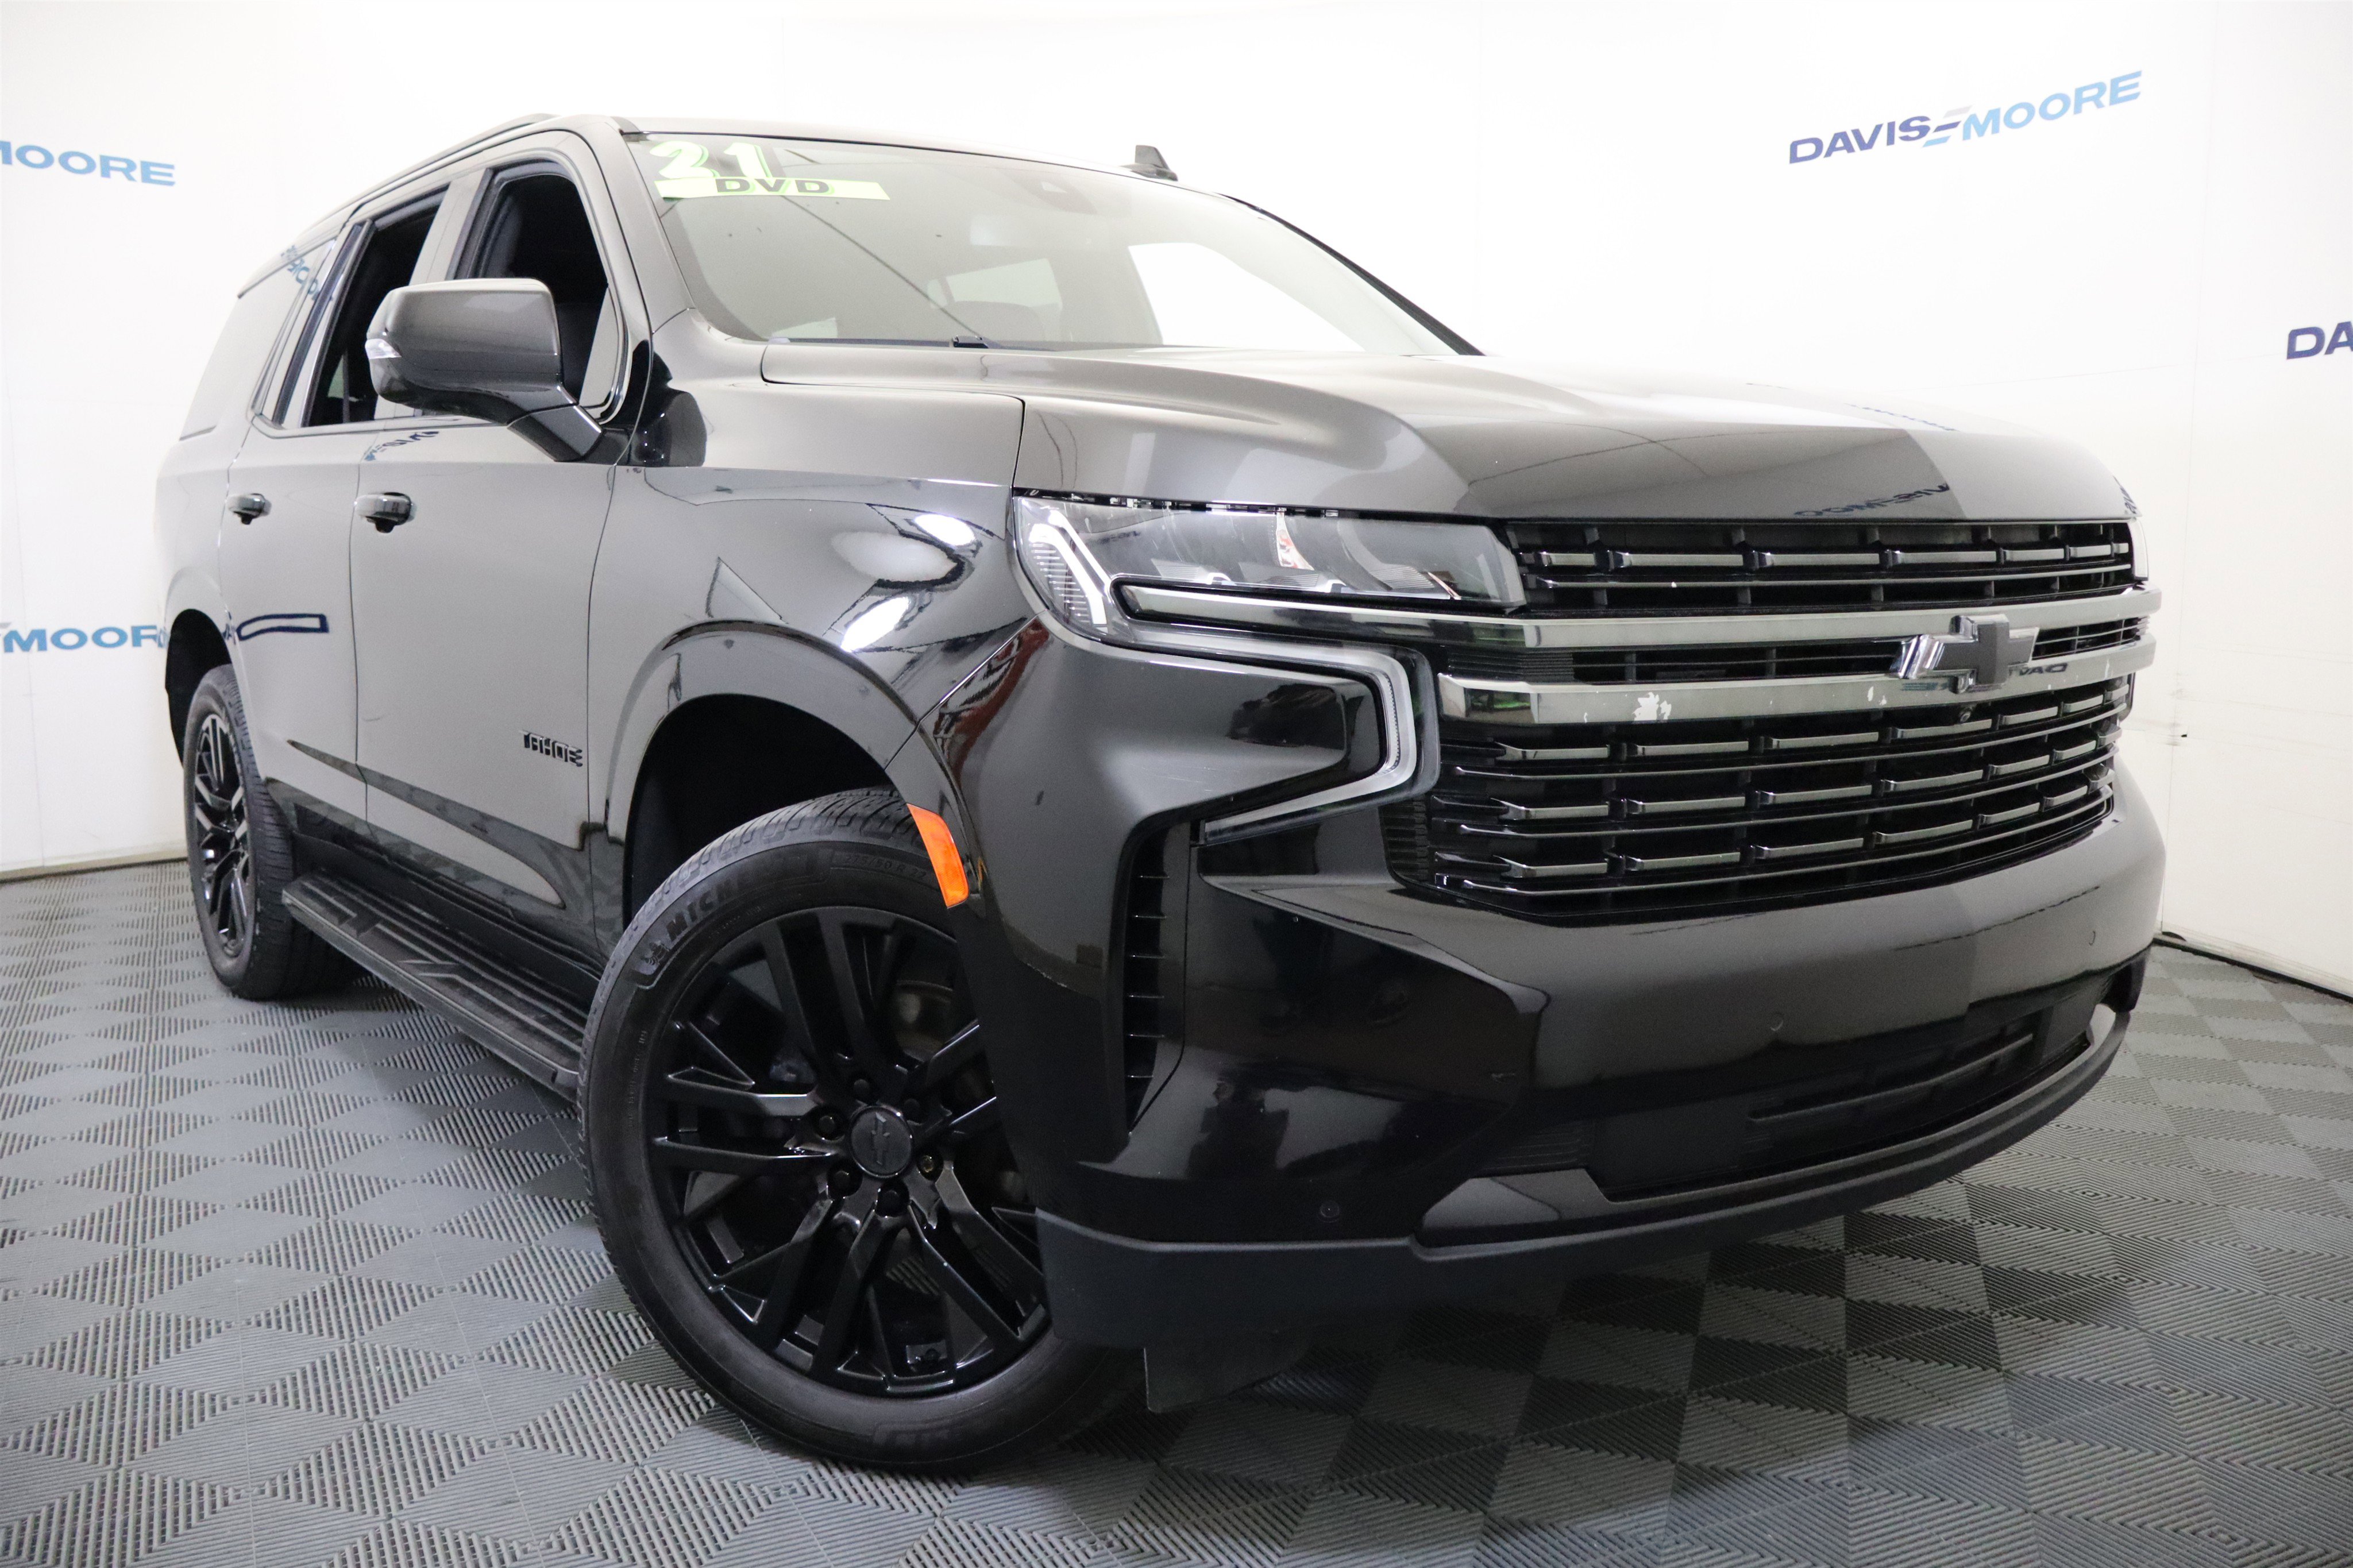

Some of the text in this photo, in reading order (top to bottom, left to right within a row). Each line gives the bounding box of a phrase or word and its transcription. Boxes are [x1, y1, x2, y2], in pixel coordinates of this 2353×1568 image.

[1789, 69, 2143, 164] DAVIS MOORE
[0, 140, 175, 187] OORE
[649, 140, 773, 178] 21
[715, 178, 831, 195] DVD
[2286, 321, 2353, 360] DA
[3, 624, 159, 653] MOOR
[519, 729, 583, 767] TAHOE
